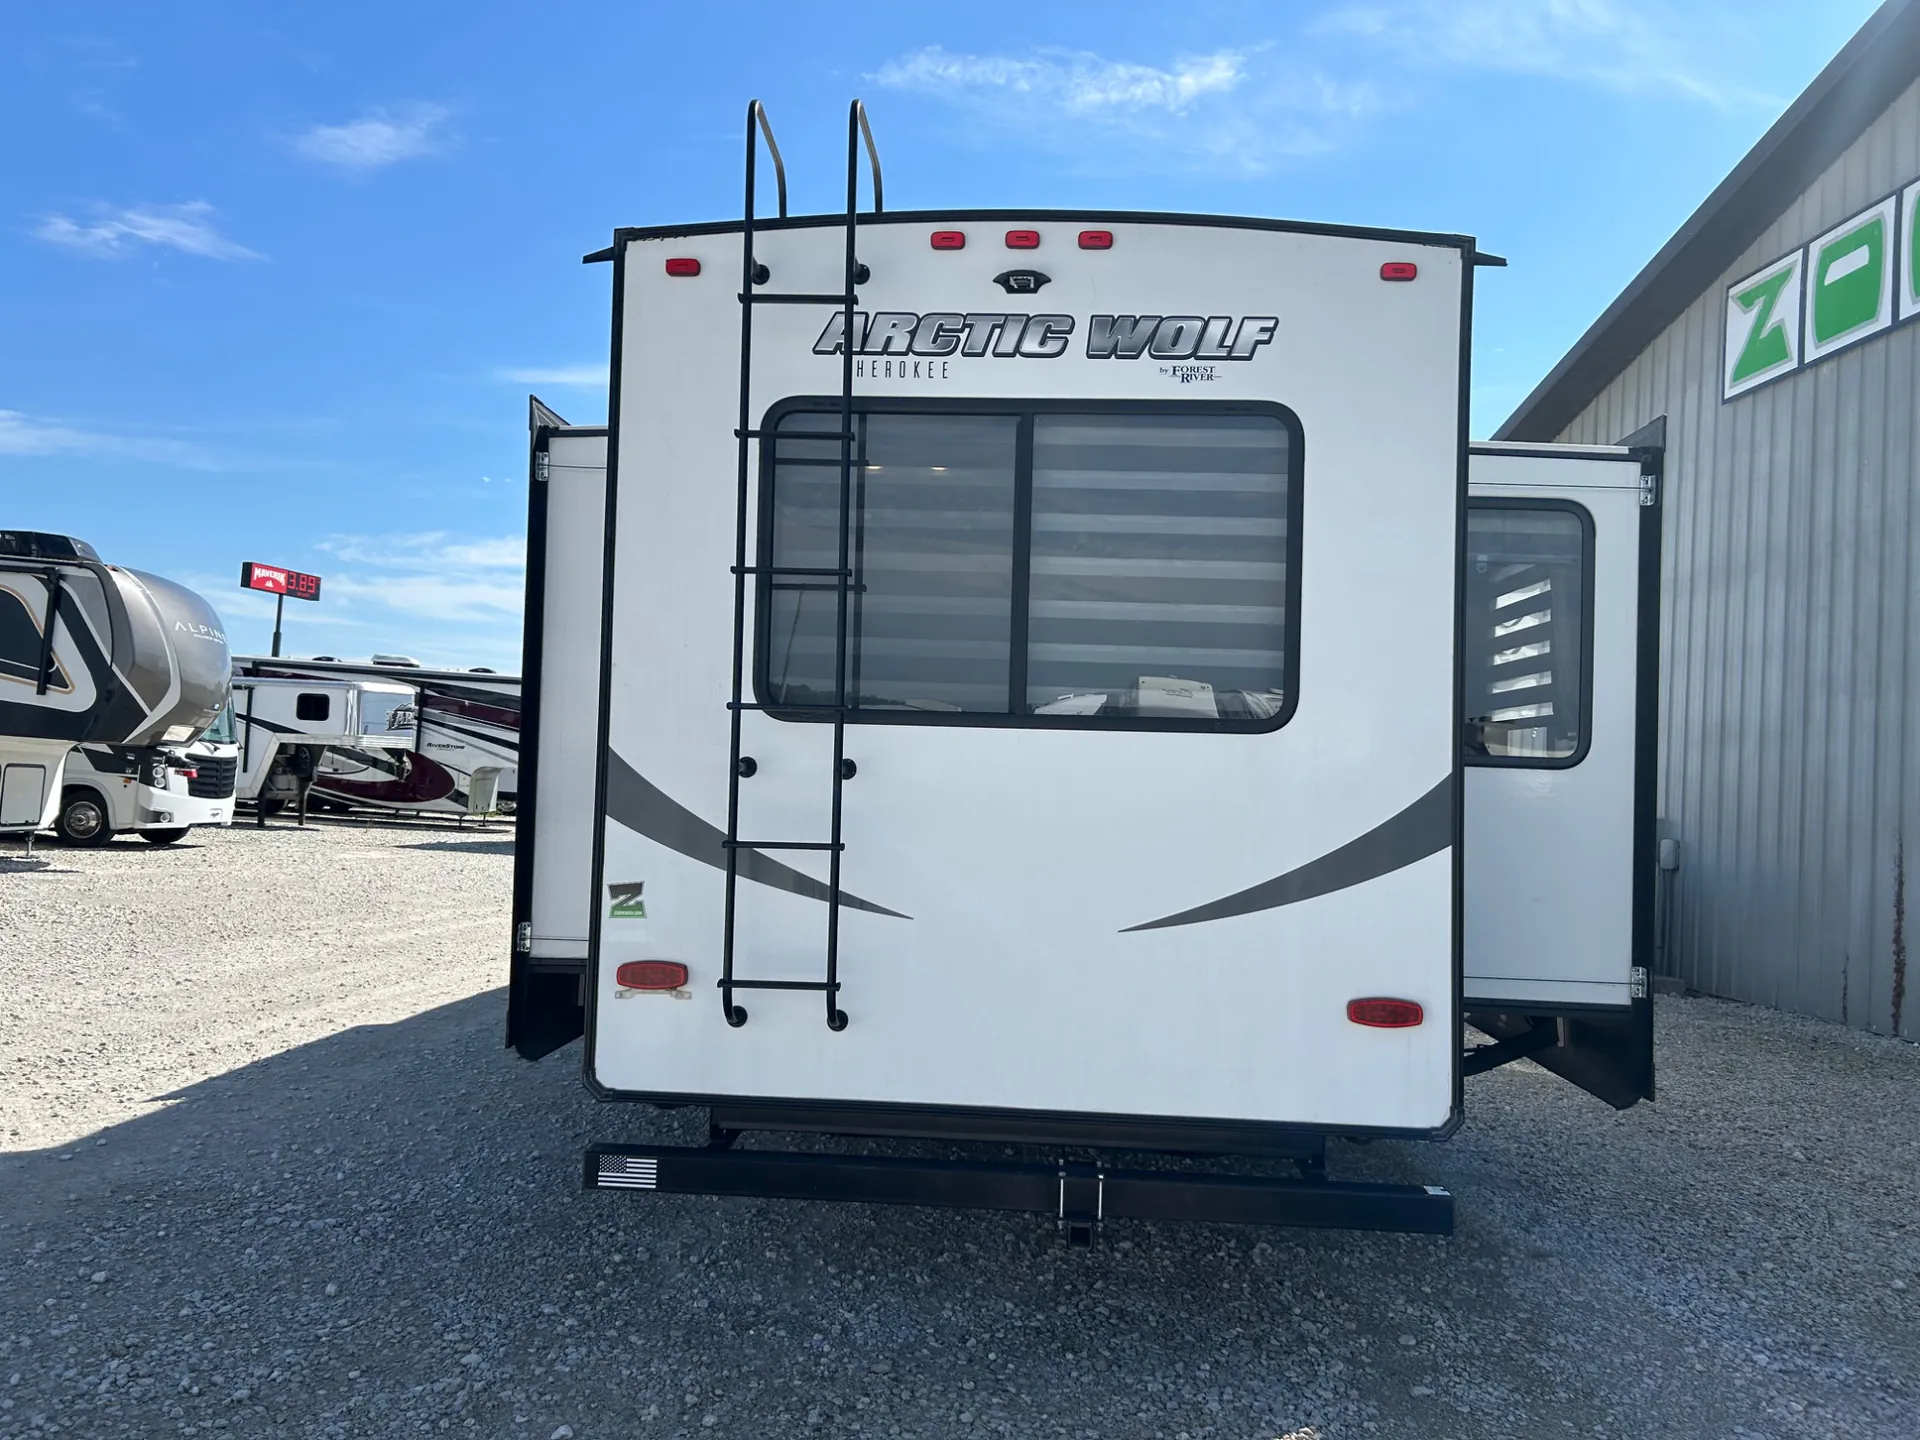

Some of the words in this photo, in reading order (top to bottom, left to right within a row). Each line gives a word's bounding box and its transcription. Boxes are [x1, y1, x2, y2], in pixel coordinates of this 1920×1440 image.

[1729, 188, 1920, 389] ZO
[812, 311, 1076, 358] ARCTIC
[1086, 314, 1280, 361] WOLF
[846, 360, 949, 379] HEROKEE
[1160, 366, 1169, 375] by
[1170, 365, 1216, 377] FOREST
[1180, 373, 1214, 383] RIVER
[254, 567, 286, 586] MAVERIK
[287, 571, 316, 594] 3.89
[175, 620, 228, 644] ALPINE
